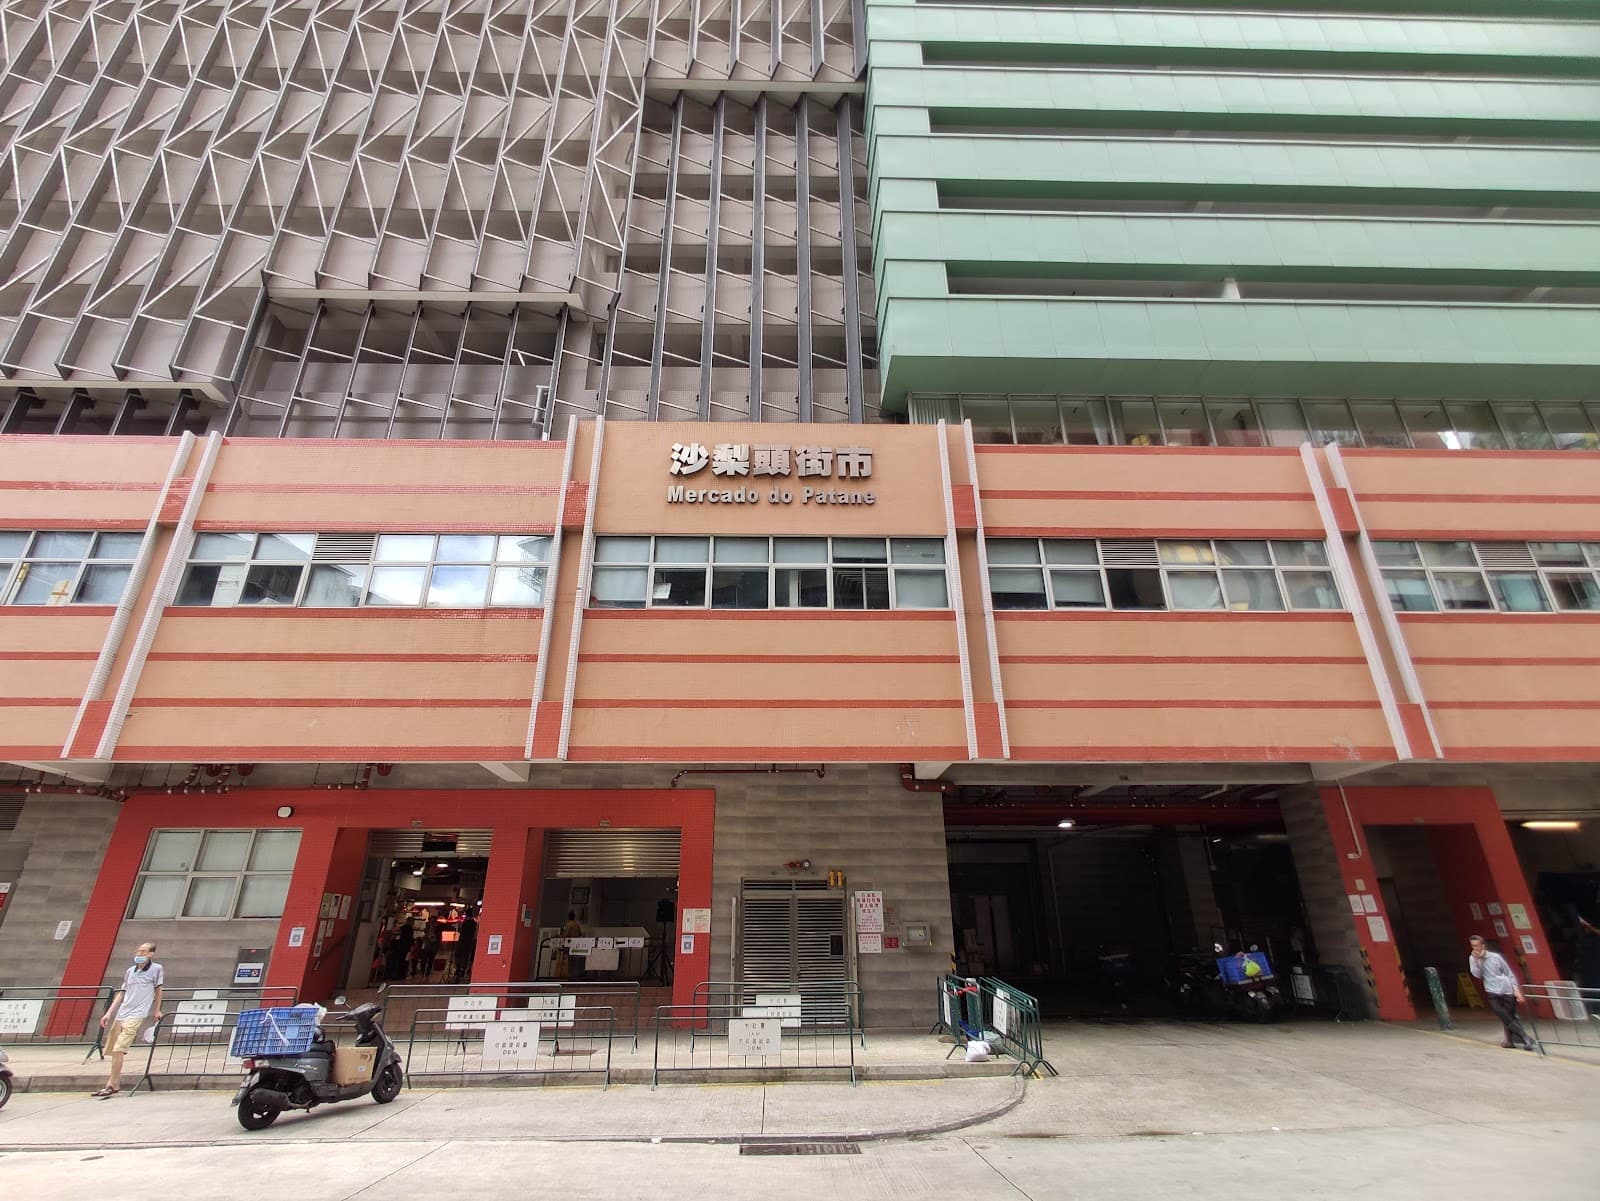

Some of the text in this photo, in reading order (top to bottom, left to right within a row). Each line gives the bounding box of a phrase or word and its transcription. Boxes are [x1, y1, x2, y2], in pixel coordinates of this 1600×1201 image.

[670, 443, 874, 478] 沙梨頭街市
[667, 485, 760, 503] Mercado
[768, 486, 793, 503] do
